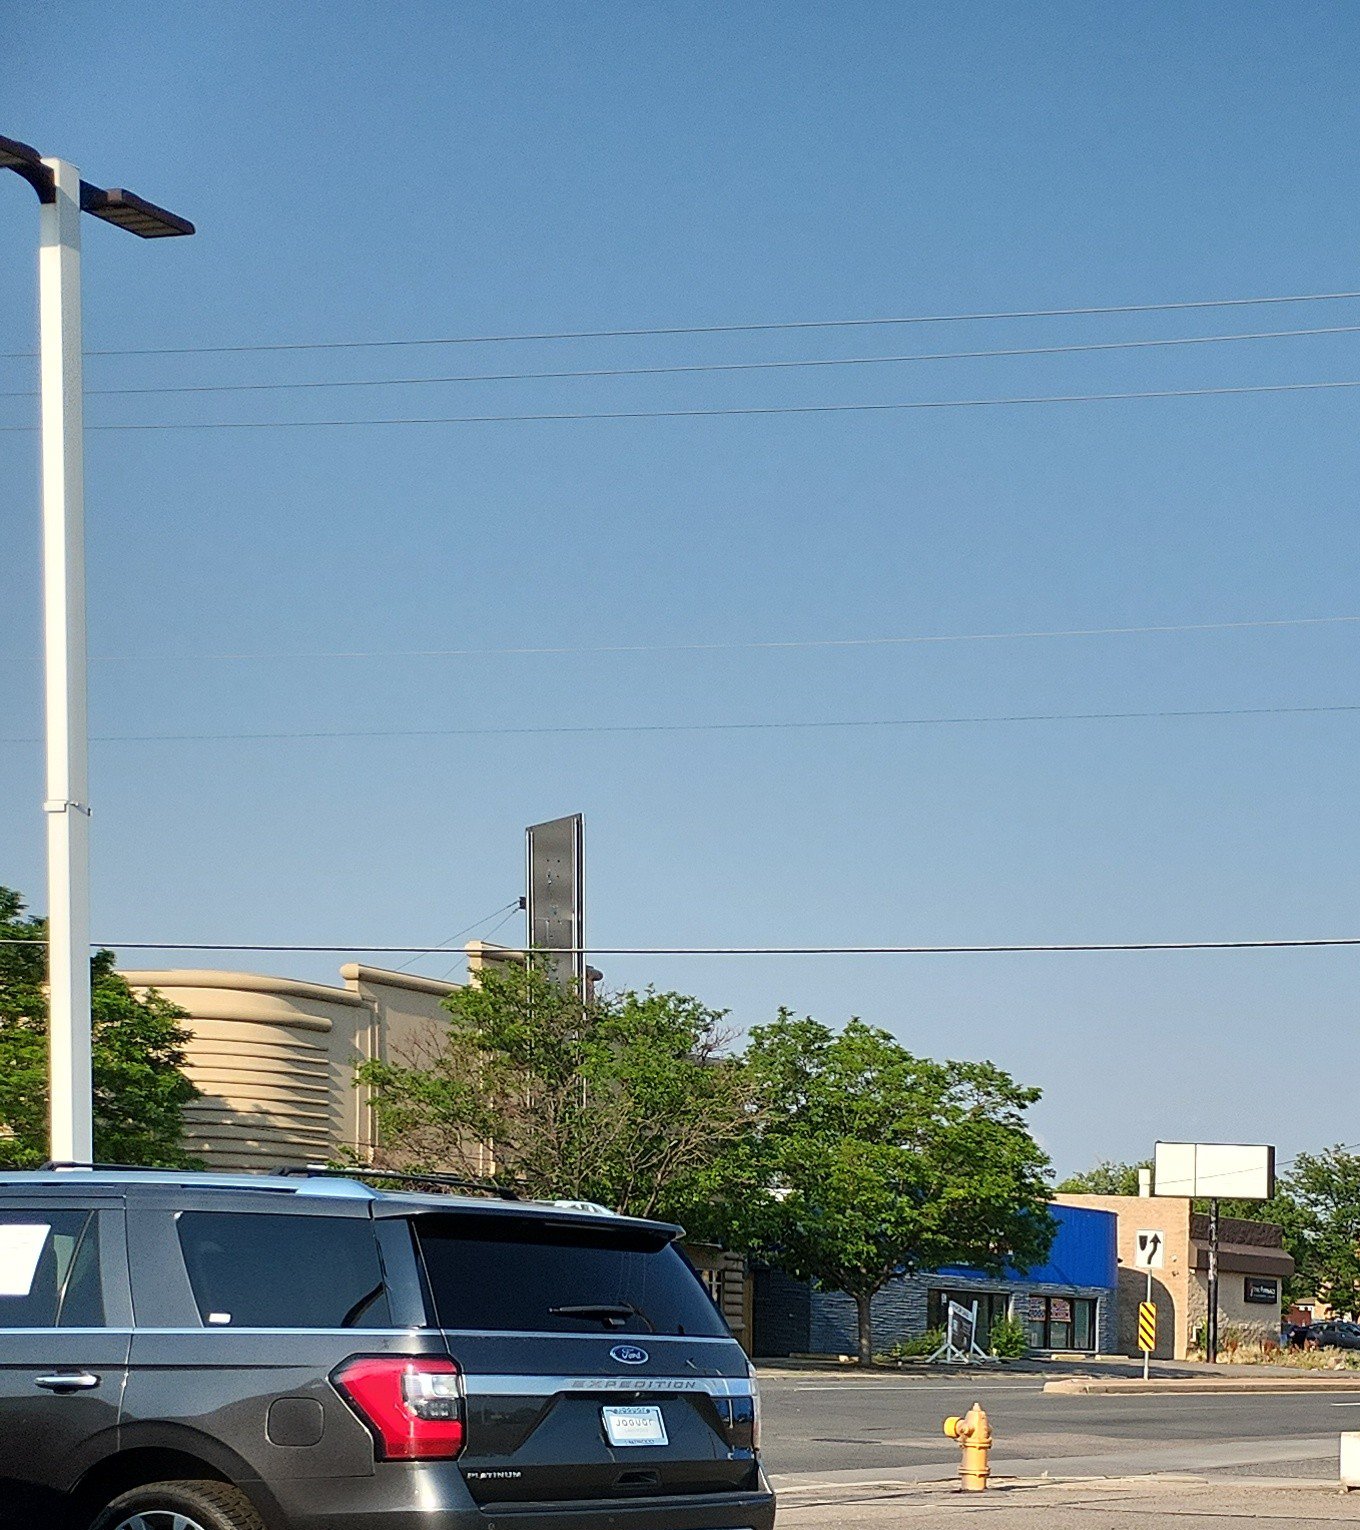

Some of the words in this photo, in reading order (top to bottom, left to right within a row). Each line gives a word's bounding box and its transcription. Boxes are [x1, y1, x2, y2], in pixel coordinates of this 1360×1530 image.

[621, 1348, 642, 1360] Ford
[571, 1380, 697, 1389] EXPEDITION
[467, 1471, 522, 1479] PLATINUM
